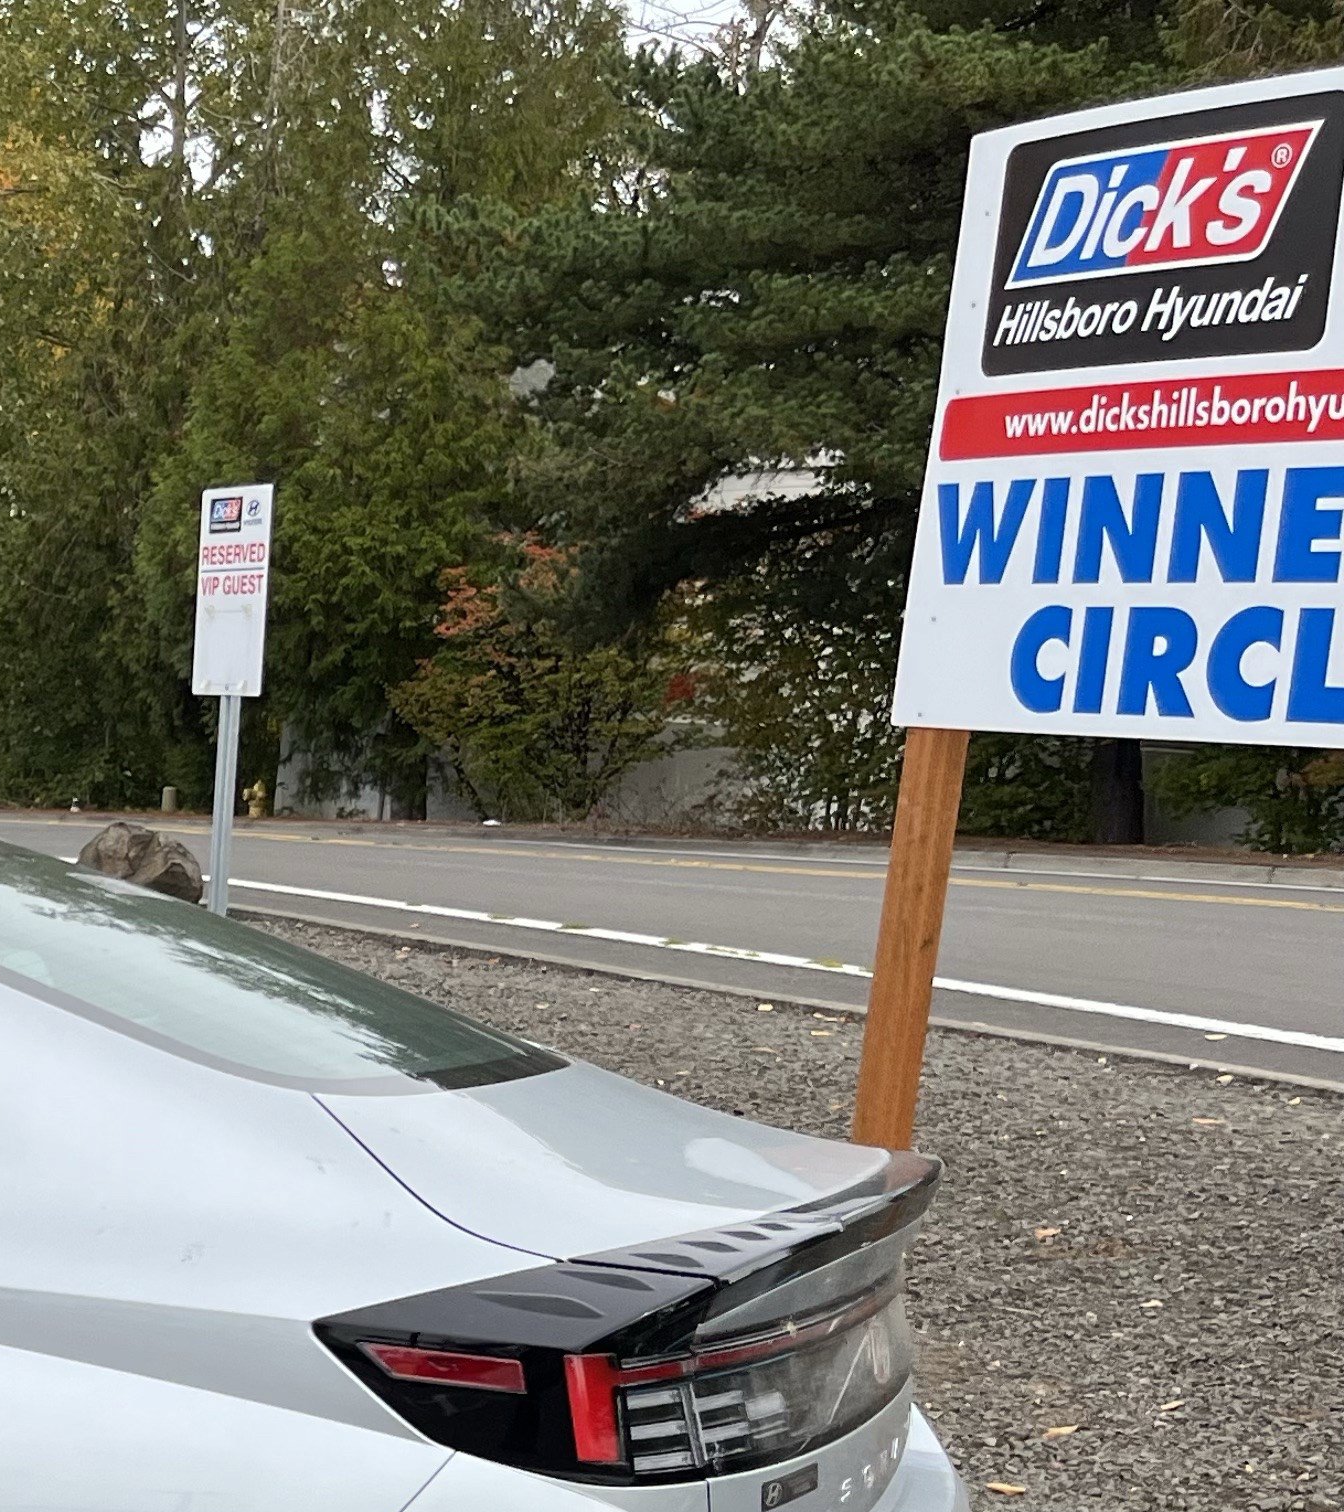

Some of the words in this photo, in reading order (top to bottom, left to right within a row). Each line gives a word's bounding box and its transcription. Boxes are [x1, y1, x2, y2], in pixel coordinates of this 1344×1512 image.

[993, 296, 1138, 347] Hillsboro
[1141, 274, 1309, 342] Hyundai
[201, 543, 265, 565] RESERVED
[201, 576, 220, 596] VIP
[223, 574, 264, 595] GUEST
